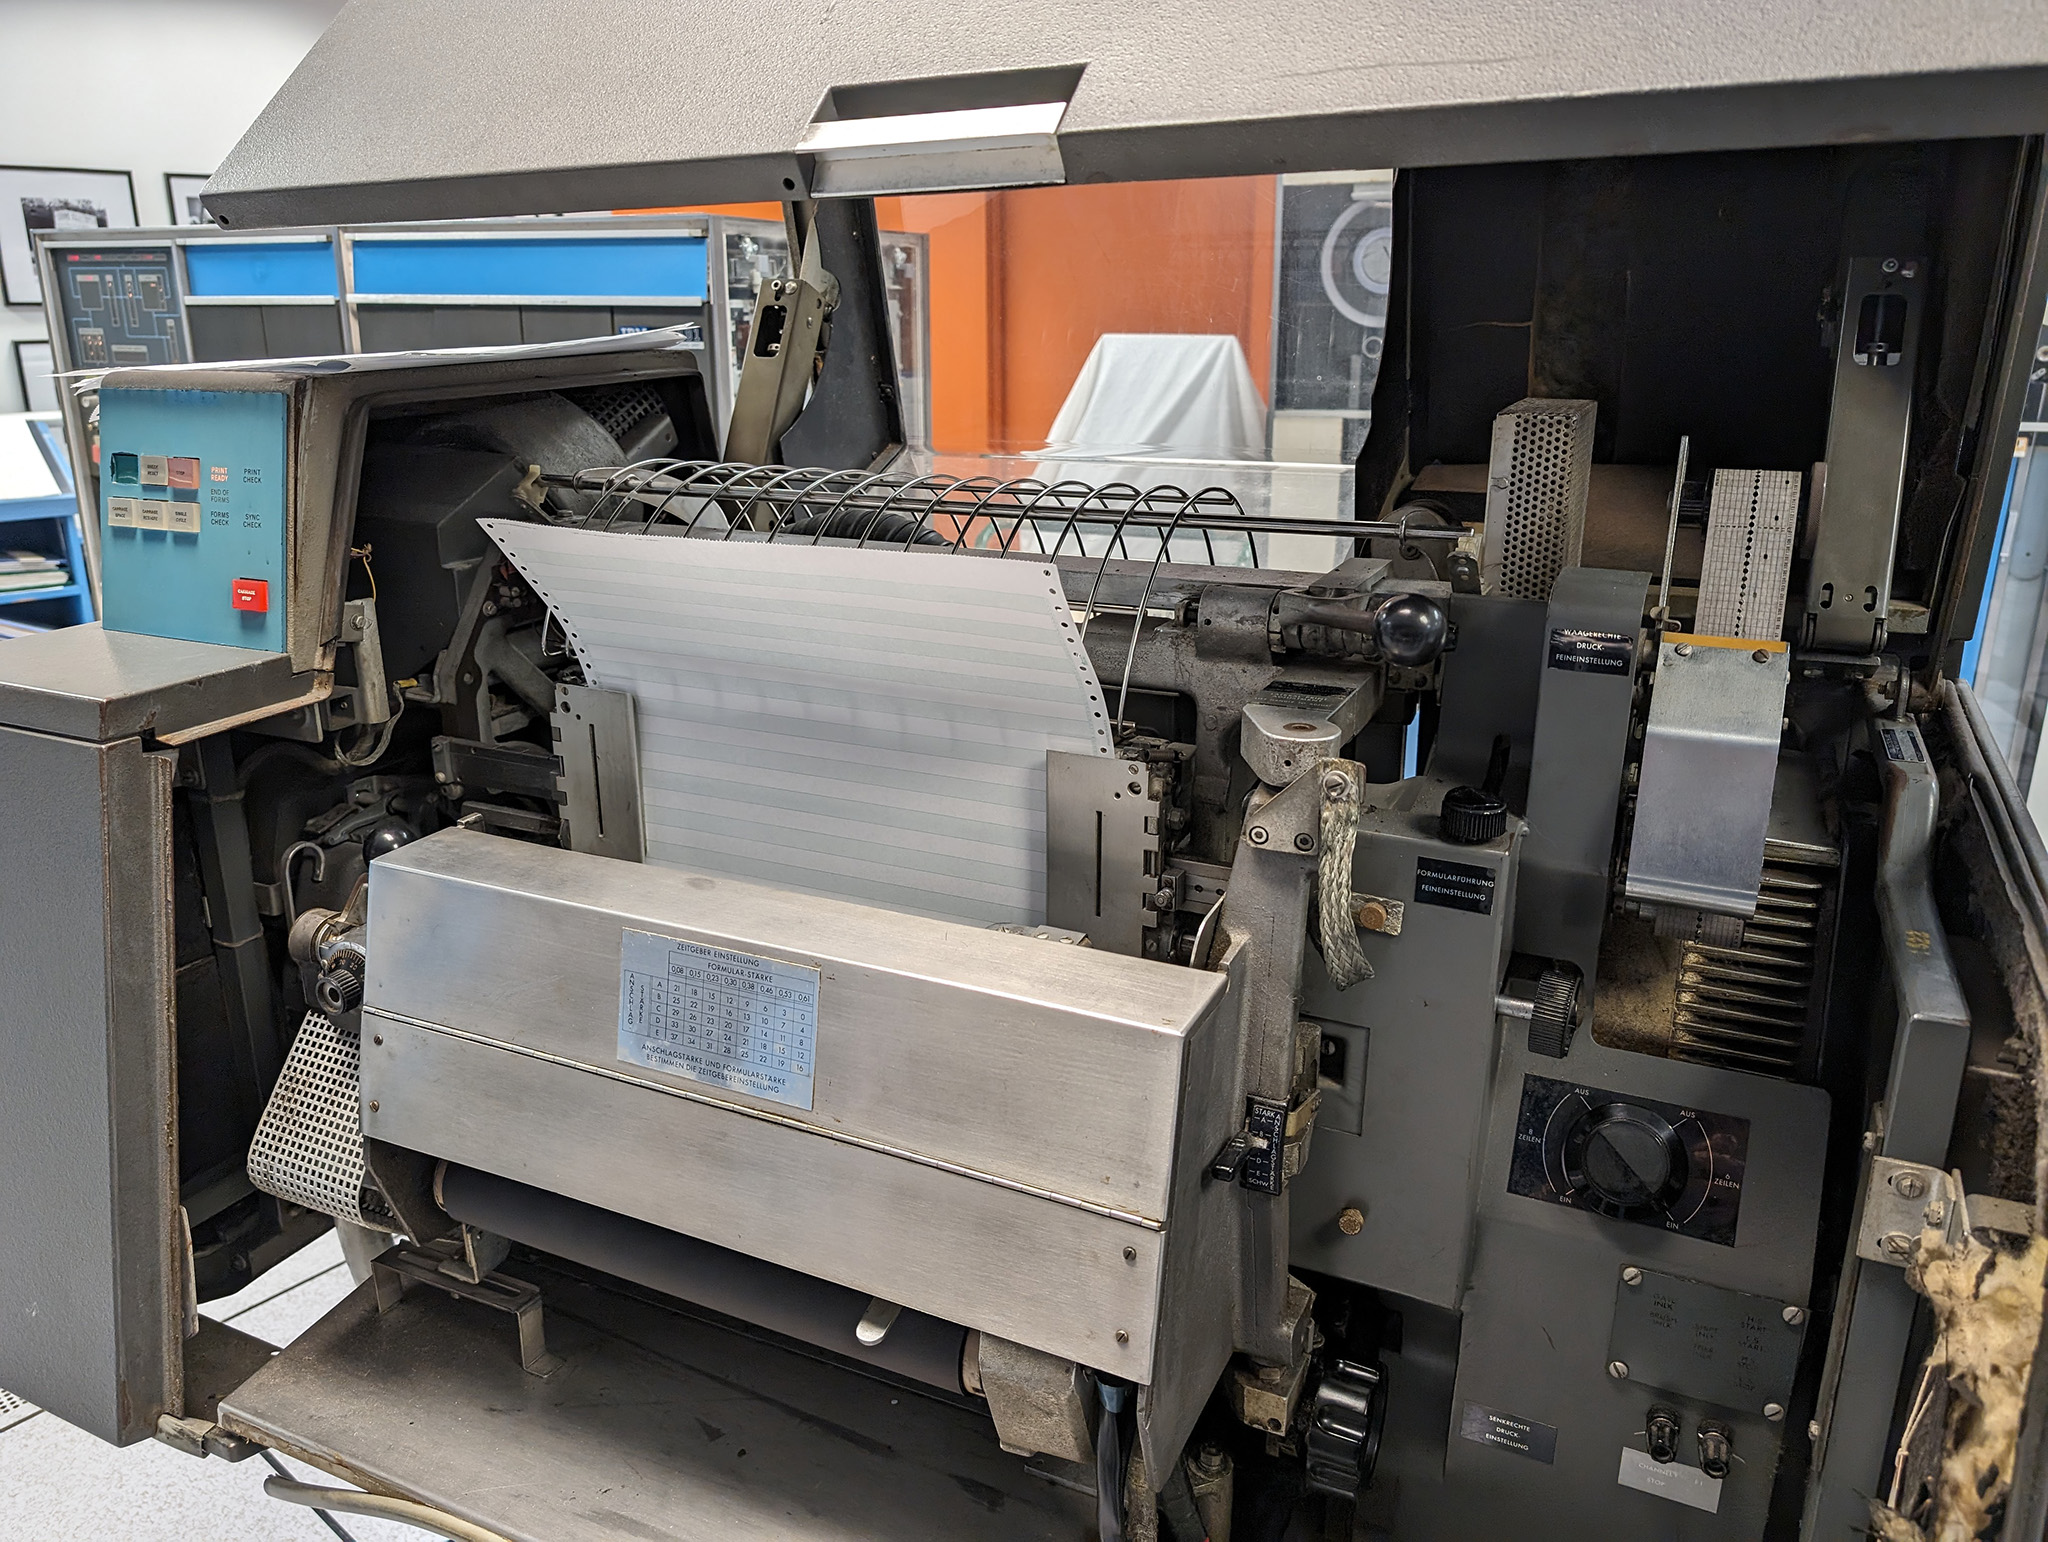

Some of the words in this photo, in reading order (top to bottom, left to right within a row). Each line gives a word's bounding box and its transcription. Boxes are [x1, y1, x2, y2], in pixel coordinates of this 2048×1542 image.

[1576, 642, 1605, 651] DRUCK-
[1556, 654, 1623, 667] FEINEINSTELLUNG
[1422, 884, 1486, 900] FEINEINSTELLUNG
[677, 943, 711, 956] ZEITGEBER
[714, 951, 760, 967] EINSTELLUNG
[672, 966, 684, 974] 0,08
[689, 970, 701, 978] 0,15
[706, 973, 719, 982] 0,23
[724, 976, 737, 987] 0,30
[742, 982, 754, 990] 0,38
[779, 990, 792, 998] 0,53
[798, 994, 810, 1002] 0,61
[642, 1044, 702, 1064] ANSCHLAGSTÄRKE
[705, 1060, 721, 1069] UND
[722, 1064, 786, 1086] FORMULARSTÄRKE
[646, 1054, 685, 1068] BESTIMMEN
[686, 1064, 697, 1072] DIE
[698, 1067, 780, 1094] ZEITGEBEREINSTELLUNG
[1574, 1088, 1590, 1096] AUS
[1255, 1107, 1276, 1117] STARK
[1680, 1110, 1696, 1119] AUS
[1518, 1134, 1541, 1144] ZEILEN
[1714, 1178, 1740, 1189] ZEILEN
[1559, 1196, 1572, 1204] EIN
[1666, 1221, 1679, 1230] EIN
[1489, 1415, 1530, 1432] SENKRECHTE
[1496, 1427, 1521, 1438] DRUCK-
[1486, 1433, 1529, 1451] EINSTELLUNG
